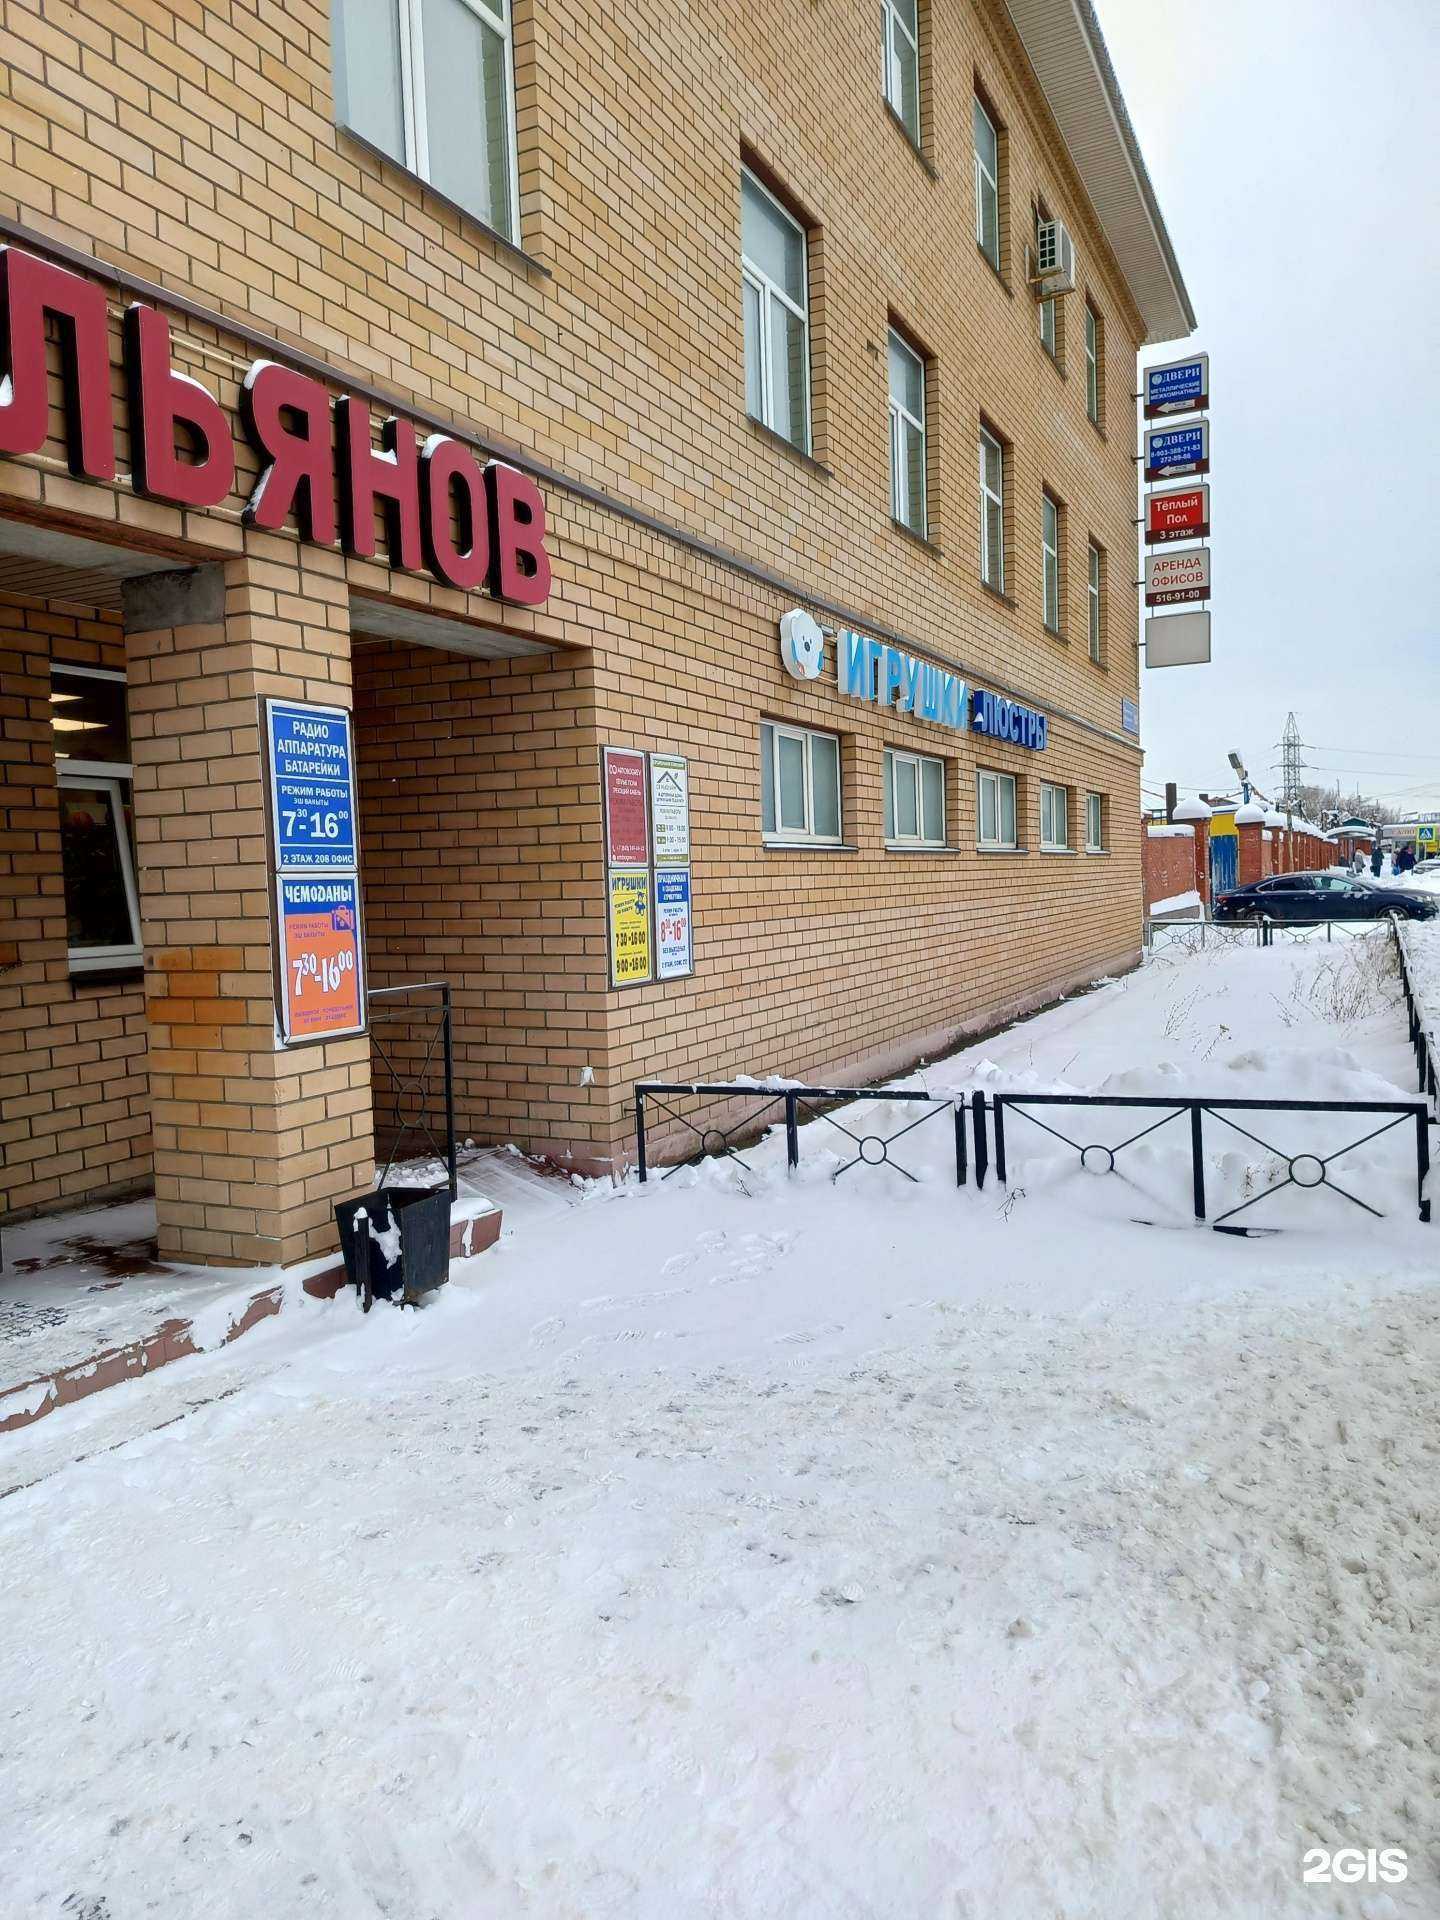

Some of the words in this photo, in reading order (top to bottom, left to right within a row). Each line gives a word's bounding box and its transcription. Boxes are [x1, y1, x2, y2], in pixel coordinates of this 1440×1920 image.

[1162, 367, 1200, 384] ДВЕРИ
[1162, 430, 1200, 446] ДВЕРИ
[1155, 496, 1198, 512] Тёплый
[1166, 514, 1188, 525] Пол
[1159, 530, 1166, 540] 3
[1168, 527, 1194, 538] этаж
[1153, 557, 1202, 573] АРЕНДА
[1152, 571, 1204, 587] ОФИСОВ
[1155, 590, 1200, 602] 516-91-00
[837, 628, 971, 731] ИГРУШКИ
[292, 720, 329, 740] РАДИО
[975, 696, 1048, 750] ЛЮСТРЫ
[277, 738, 346, 760] АППАРАТУРА
[285, 759, 341, 777] БАТАРЕЙКИ
[281, 785, 314, 796] РЕЖИМ
[316, 787, 348, 799] РАБОТЫ
[283, 854, 289, 863] 2
[291, 854, 313, 863] ЭТАЖ
[331, 854, 353, 864] ОФИС
[285, 885, 352, 903] ЧЕМОДАНЫ
